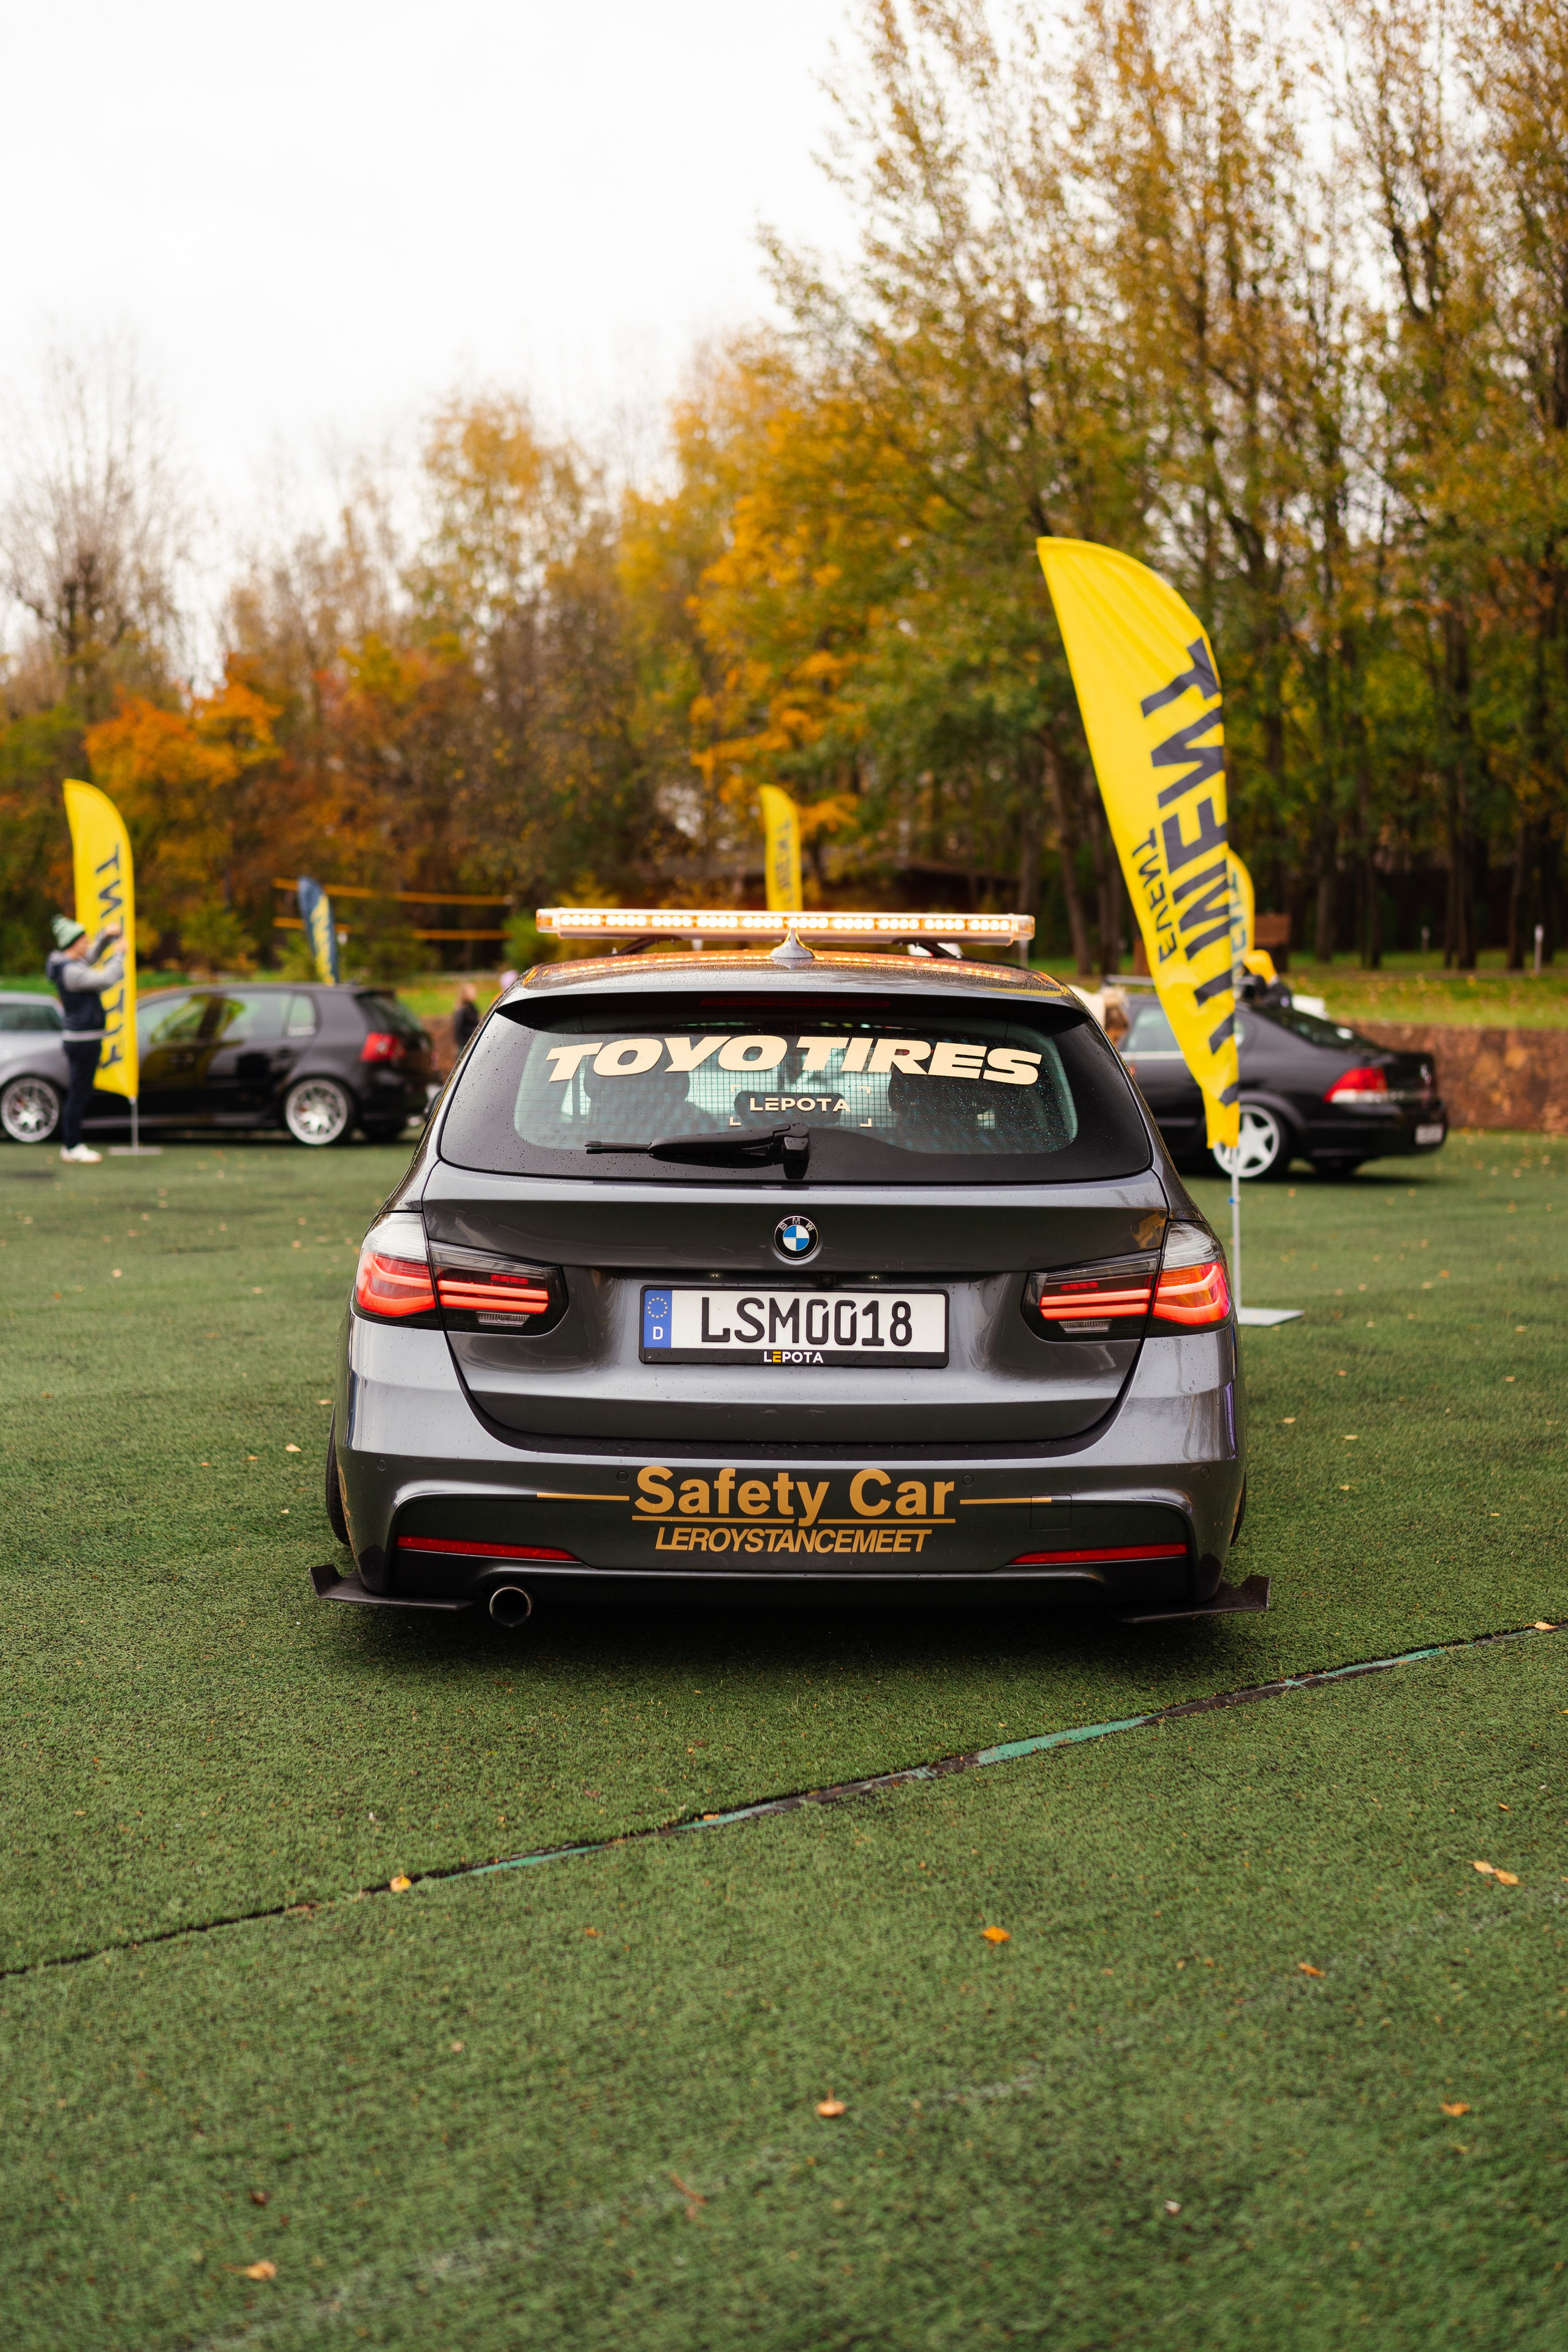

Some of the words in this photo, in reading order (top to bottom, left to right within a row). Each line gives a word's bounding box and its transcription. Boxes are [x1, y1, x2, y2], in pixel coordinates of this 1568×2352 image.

[546, 1035, 787, 1081] TOYO
[796, 1036, 1042, 1085] TIRES
[750, 1098, 851, 1112] LEPOTA
[778, 1218, 815, 1232] BMW
[652, 1326, 663, 1340] D
[764, 1351, 824, 1363] LEPOTA
[635, 1466, 830, 1527] Safety
[850, 1468, 955, 1517] Car
[655, 1527, 932, 1553] LEROYSTANCEMEET
